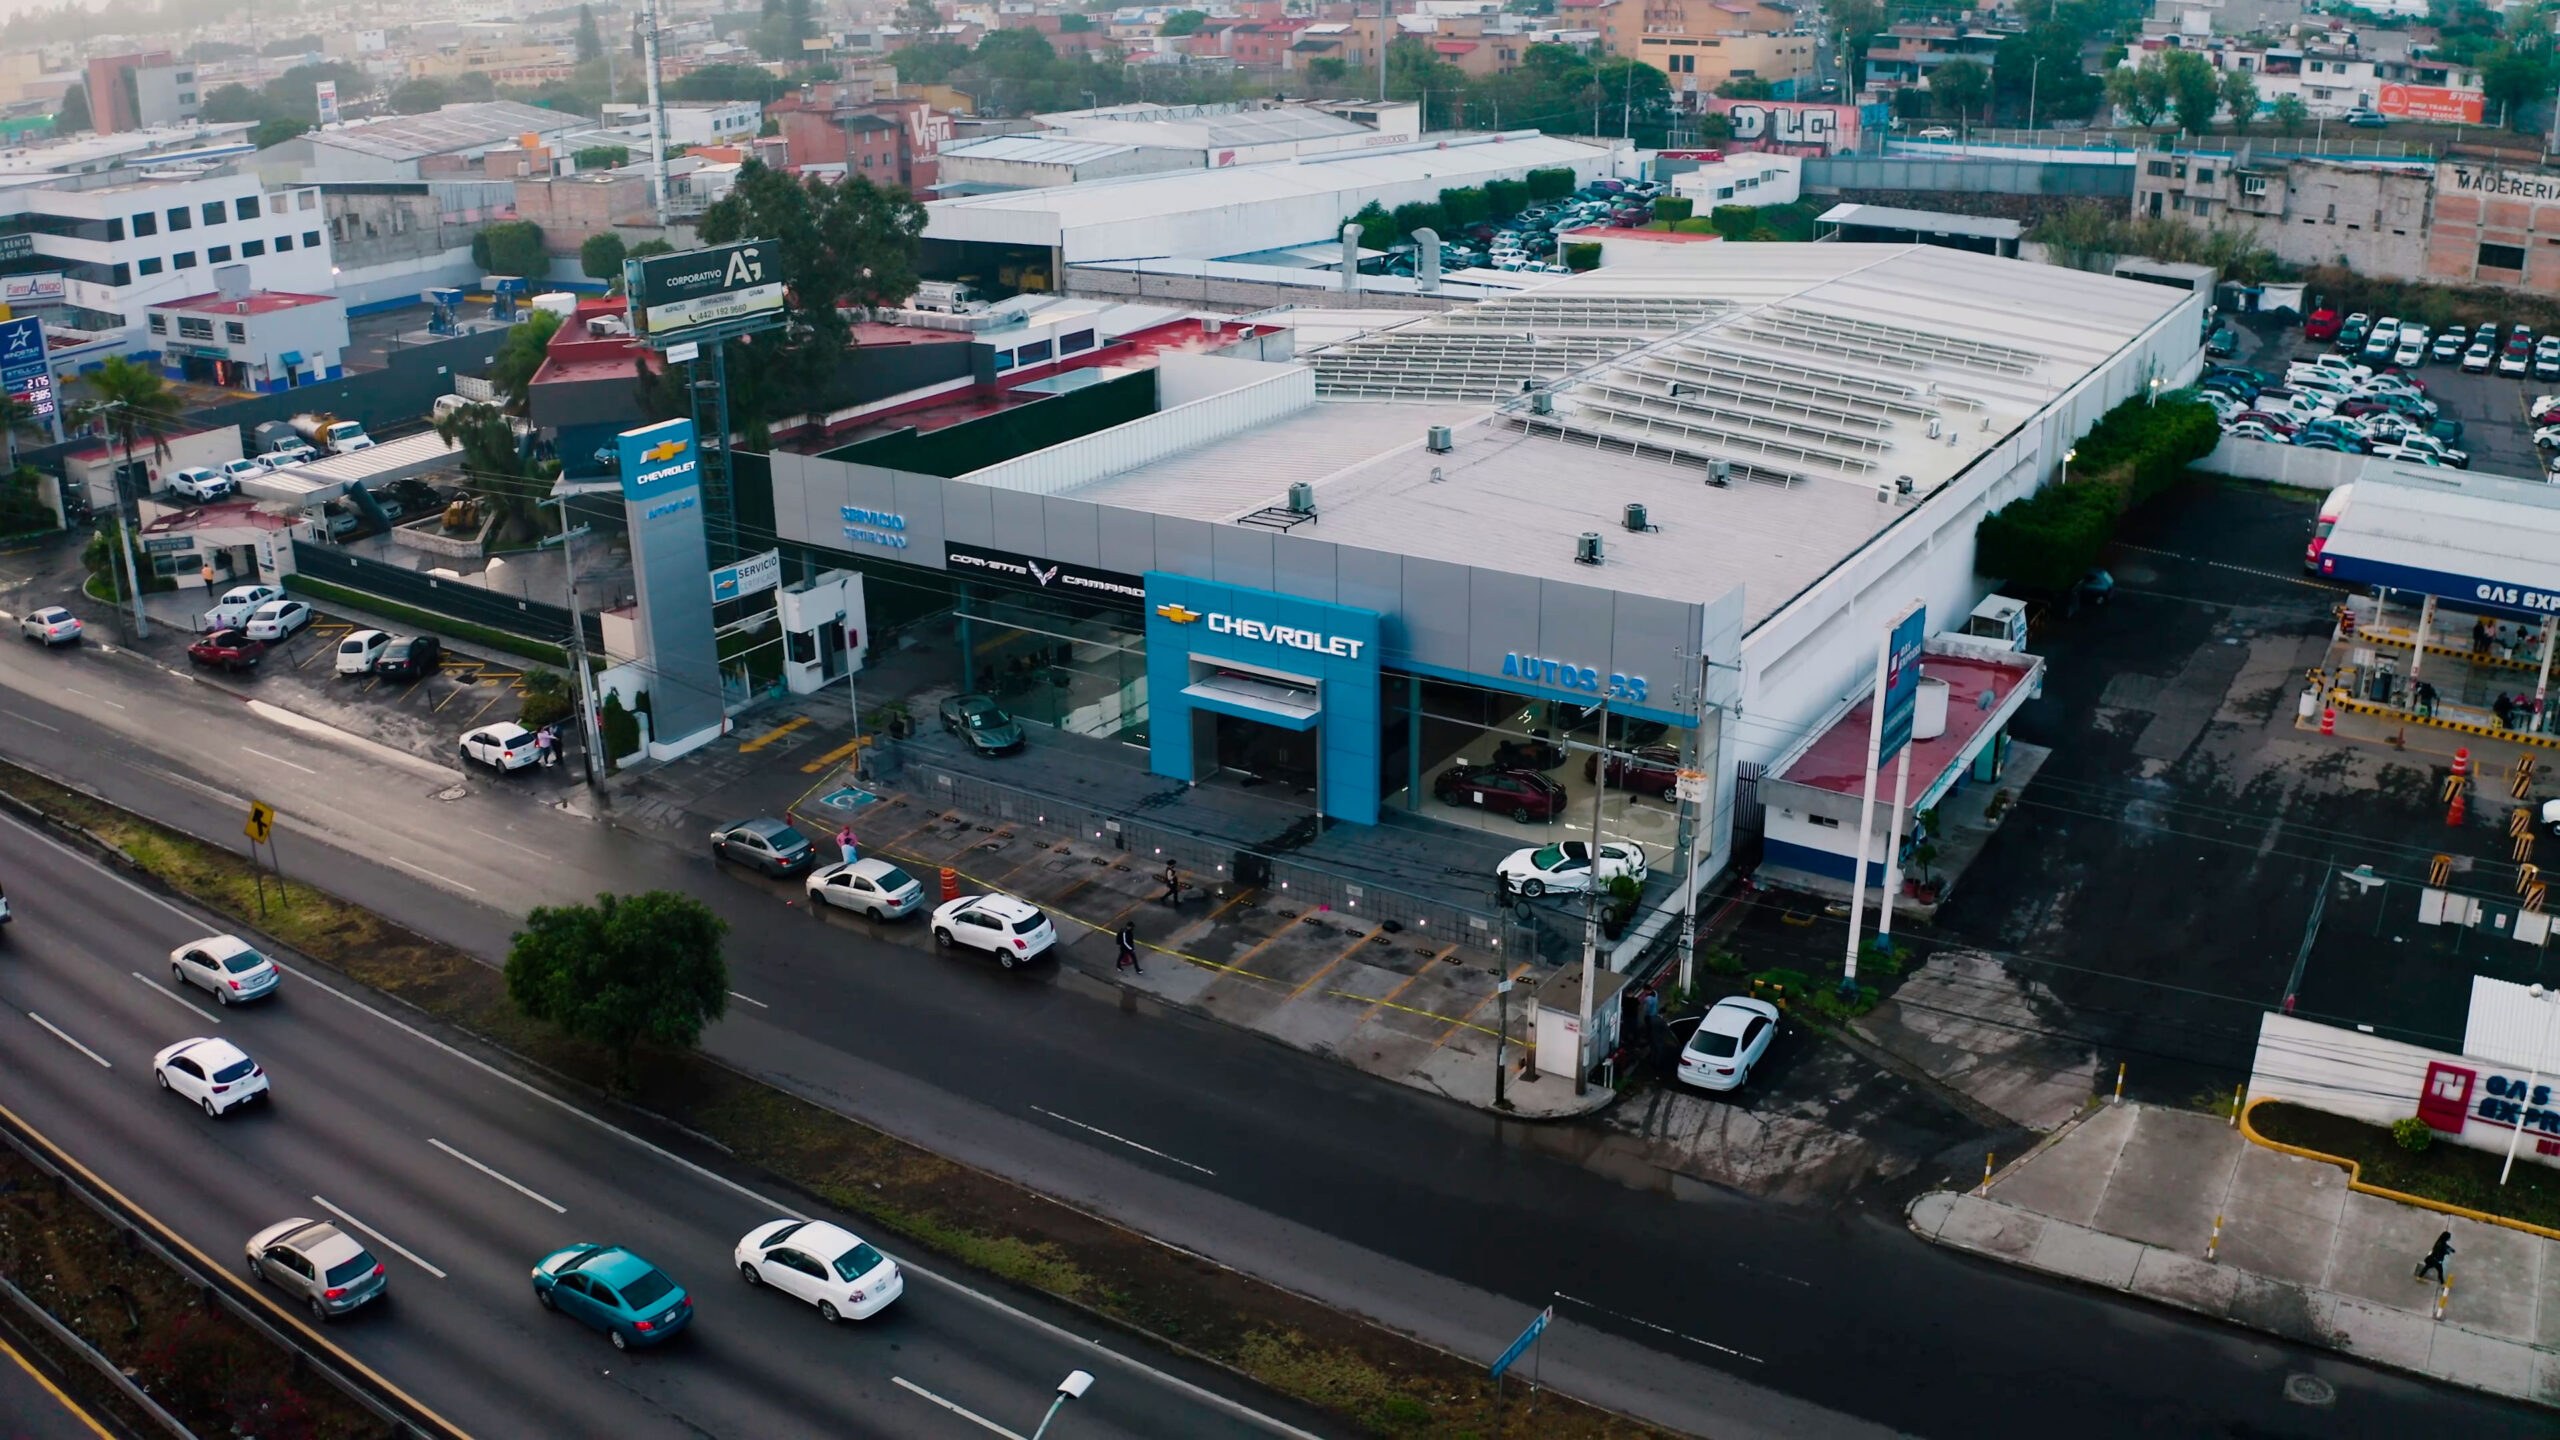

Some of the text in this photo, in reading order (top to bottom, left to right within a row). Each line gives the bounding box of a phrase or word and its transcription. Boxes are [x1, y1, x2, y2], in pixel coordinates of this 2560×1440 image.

[2449, 91, 2480, 102] STIHL
[666, 248, 761, 287] CORPORATIVO AG
[637, 460, 696, 485] CHEVROLET
[841, 505, 905, 532] SERVICIO
[738, 556, 777, 579] SERVICIO
[950, 553, 1146, 598] CORVETTE CAMARO
[2476, 584, 2518, 604] GAS
[1208, 612, 1364, 659] CHEVROLET
[1502, 652, 1598, 692] AUTOS
[2486, 1075, 2551, 1106] GAS
